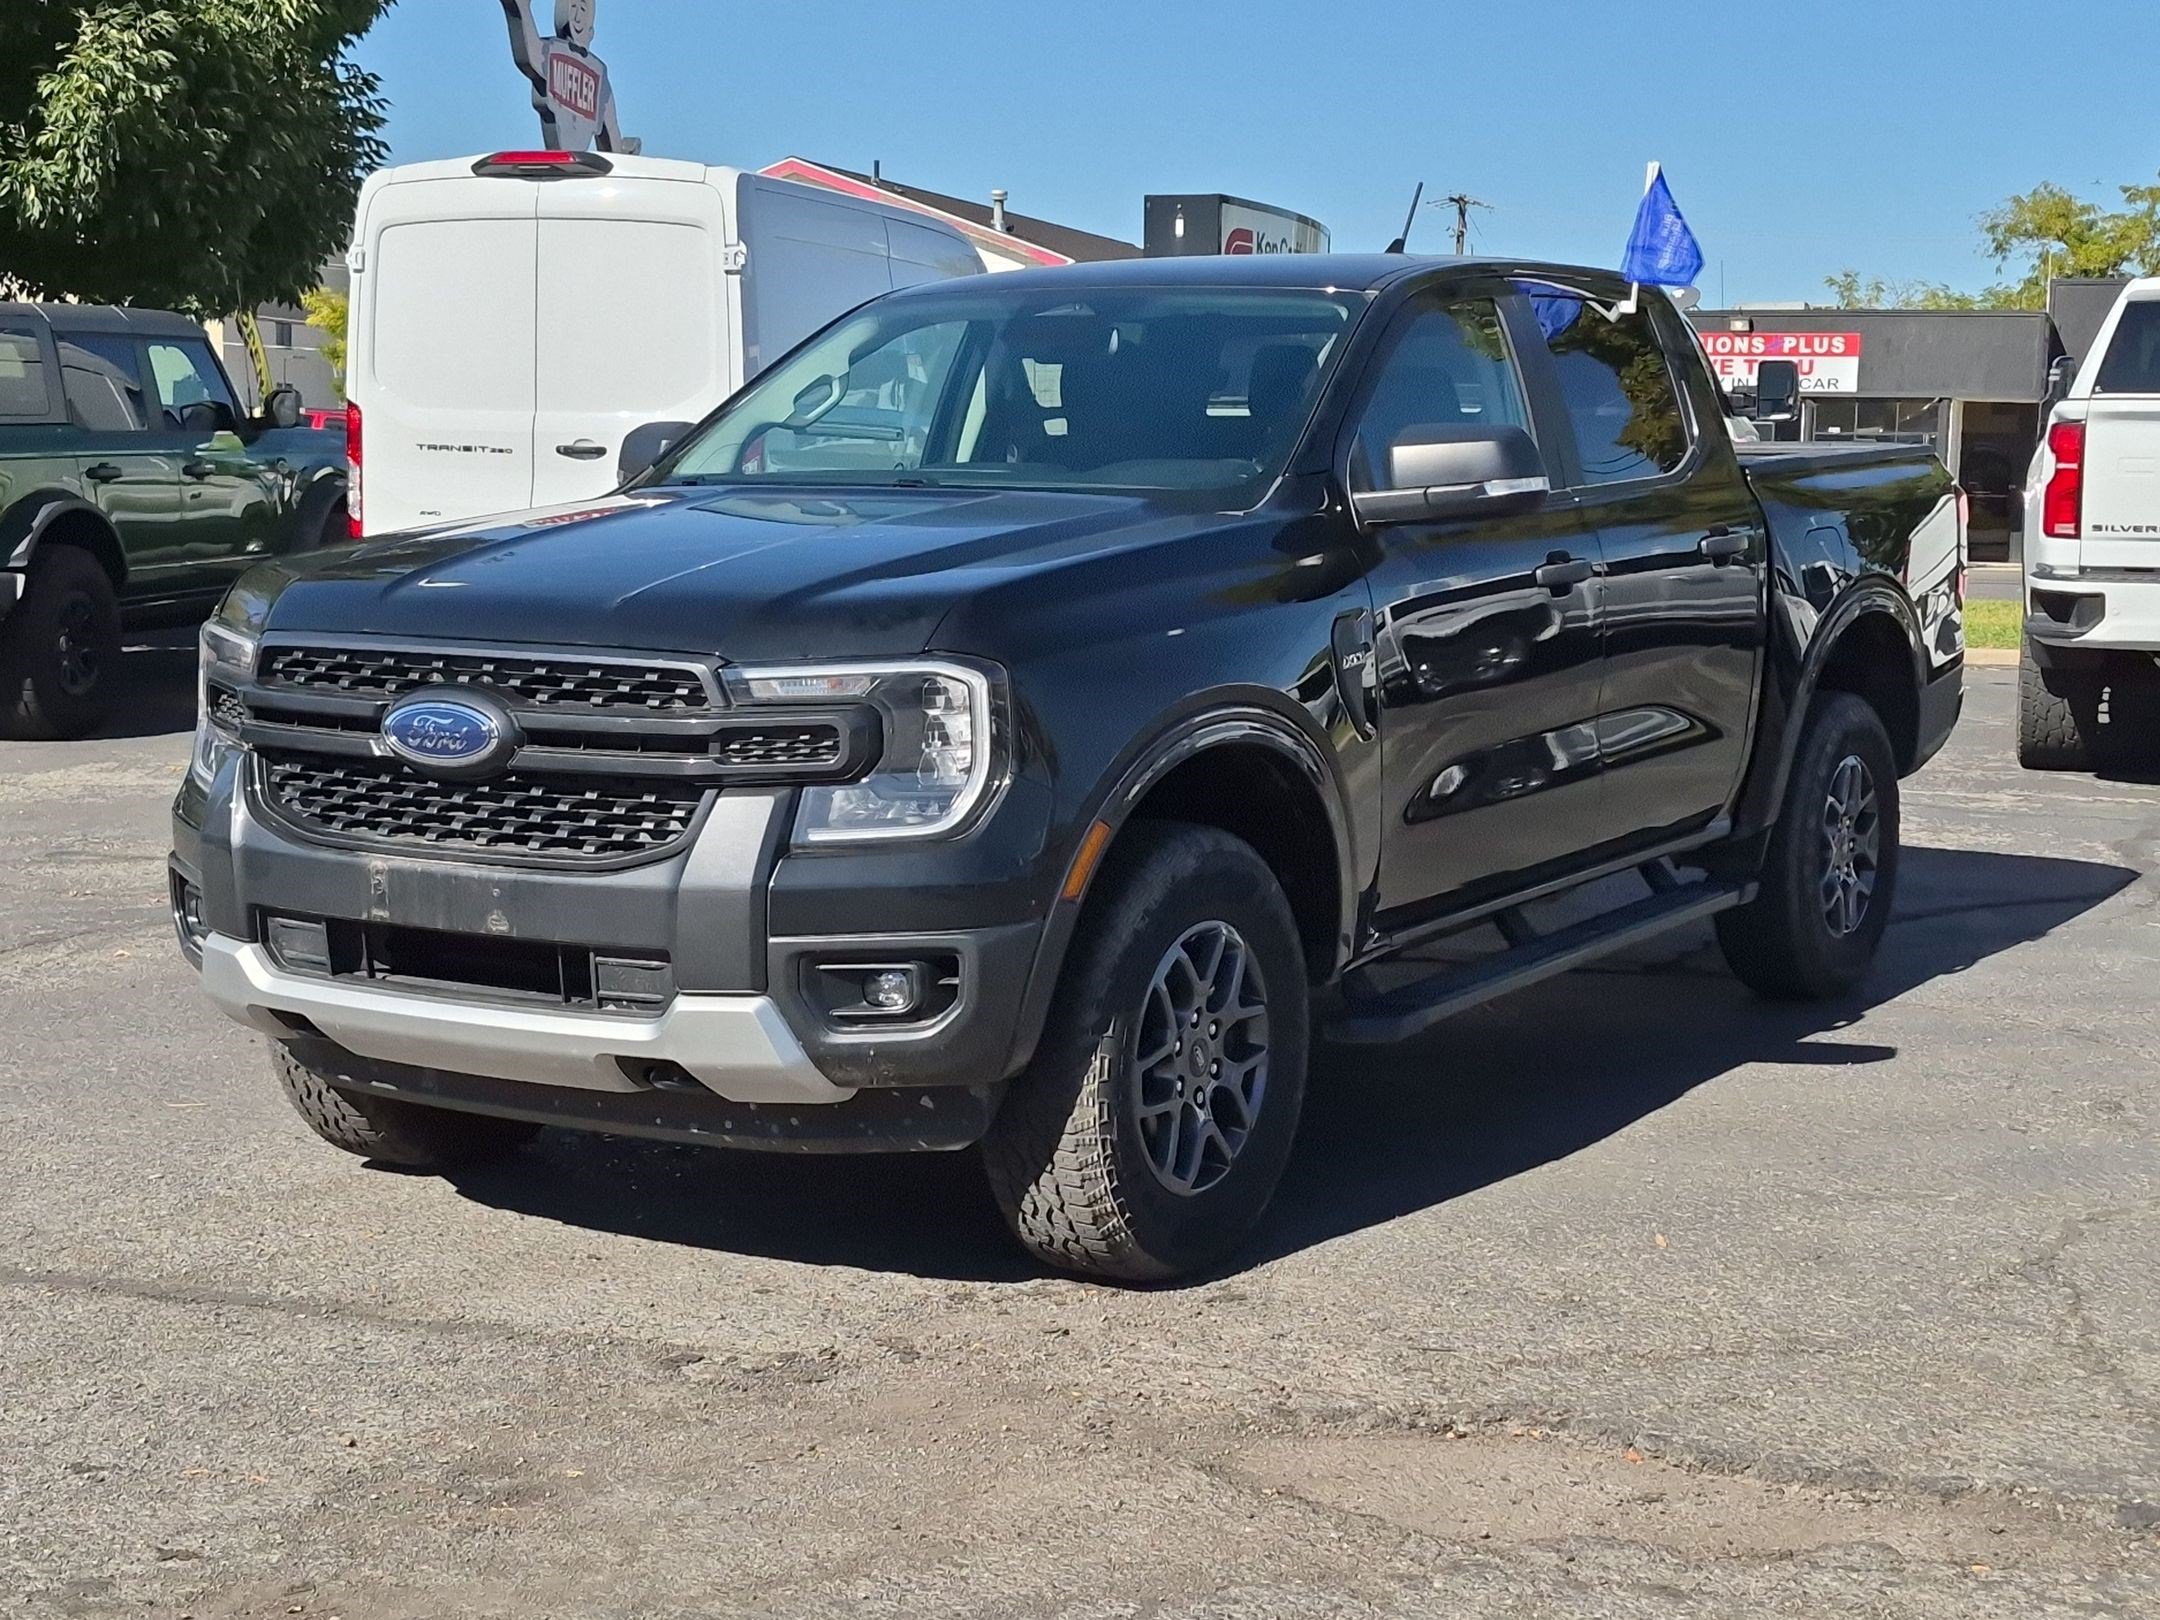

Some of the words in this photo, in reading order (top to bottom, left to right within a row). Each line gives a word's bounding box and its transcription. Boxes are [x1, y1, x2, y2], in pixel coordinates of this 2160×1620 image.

[553, 59, 595, 112] MUFFLER
[1700, 335, 1766, 354] IONS
[1781, 336, 1847, 354] PLUS
[1798, 377, 1840, 390] CAR
[416, 443, 489, 453] TRANSIT
[2092, 524, 2160, 533] SILVER
[407, 714, 470, 751] Ford
